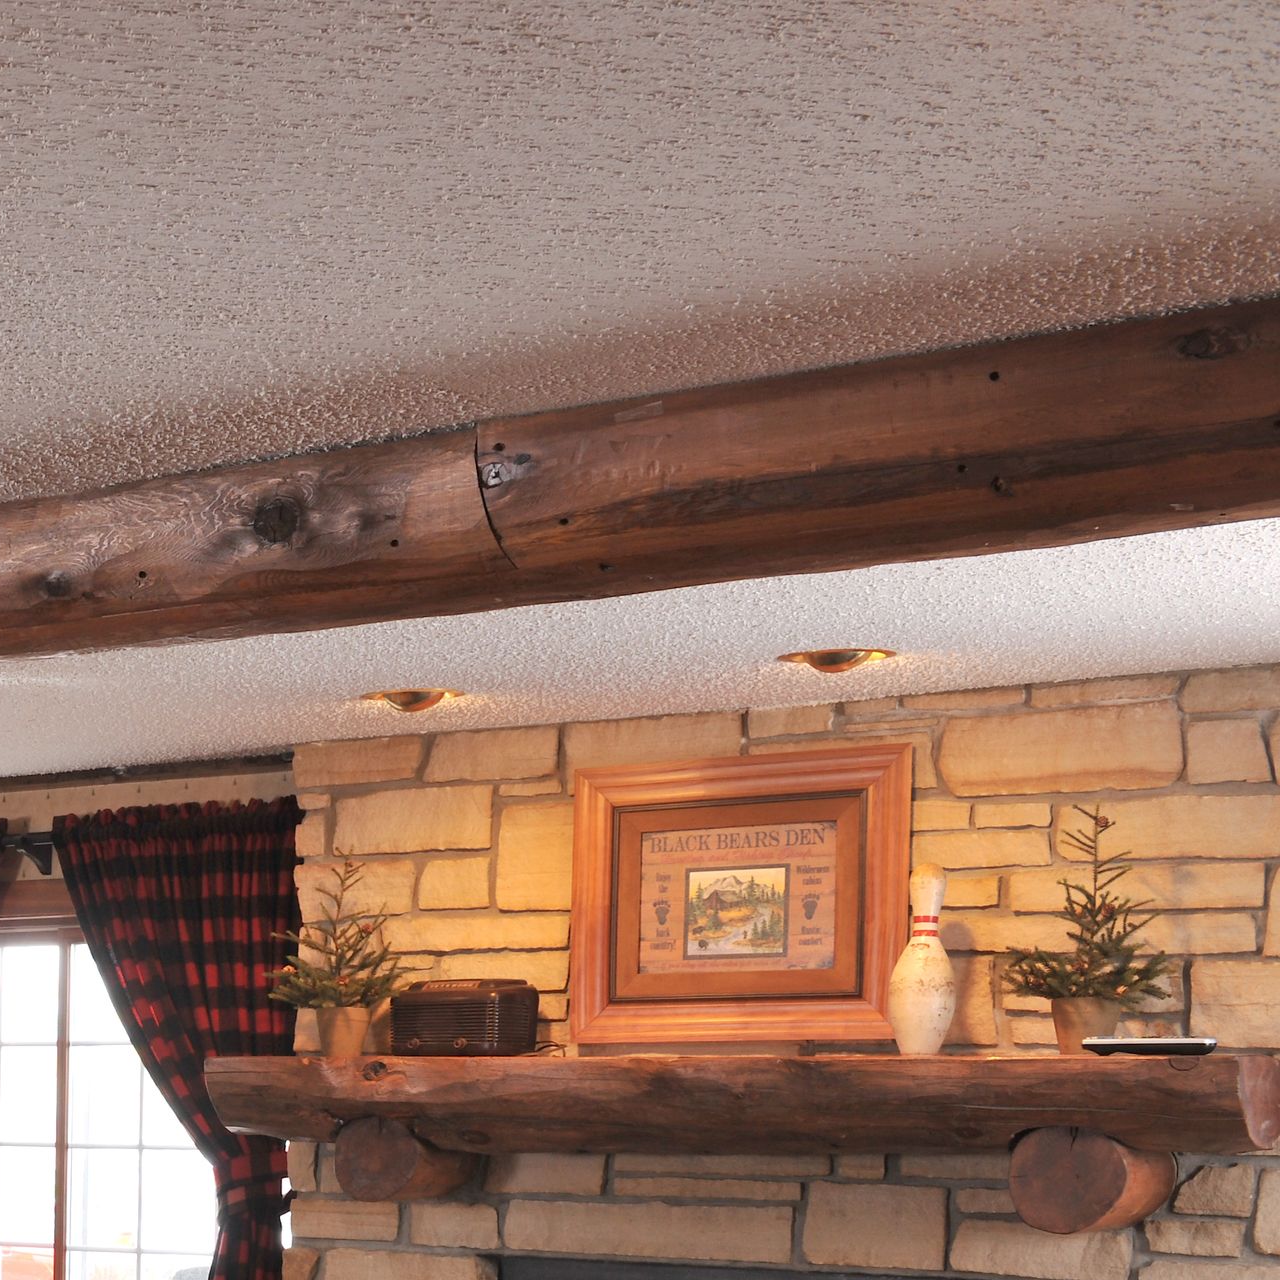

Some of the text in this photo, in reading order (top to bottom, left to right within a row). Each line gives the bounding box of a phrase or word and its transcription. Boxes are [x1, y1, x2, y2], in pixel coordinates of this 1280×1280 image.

[650, 828, 826, 853] BLACK BEARS DEN
